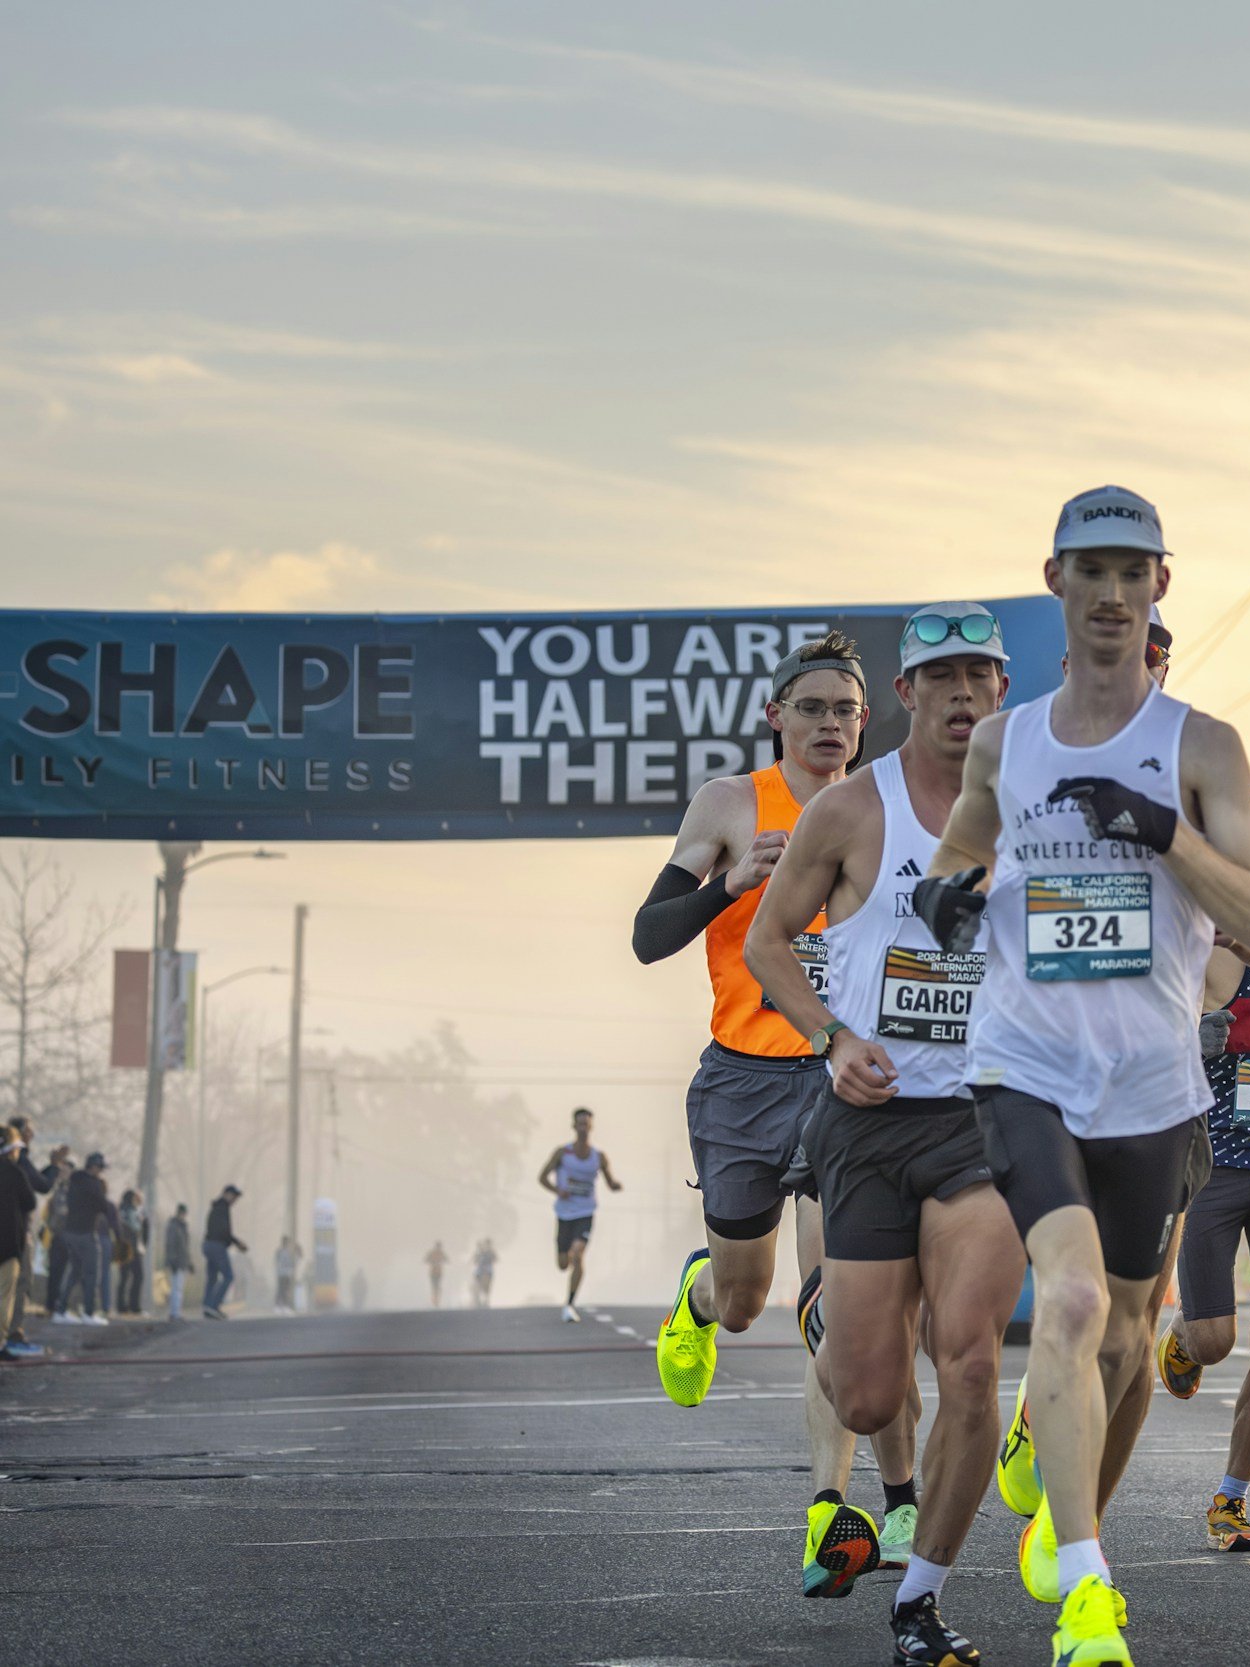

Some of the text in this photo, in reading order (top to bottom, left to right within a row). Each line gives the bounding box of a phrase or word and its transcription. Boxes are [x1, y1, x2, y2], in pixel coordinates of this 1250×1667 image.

[477, 624, 650, 677] YOU
[479, 677, 774, 738] HALFWA
[11, 752, 413, 792] ILY FITNESS
[479, 739, 774, 805] THER
[1015, 841, 1099, 862] ATHLETIC
[1081, 874, 1149, 887] CALIFORNIA
[1060, 886, 1149, 898] INTERNATIONAL
[1084, 897, 1149, 908] MARATHON
[1055, 914, 1122, 948] 324
[916, 952, 941, 961] 2024
[947, 953, 986, 963] CALIFOR
[1090, 958, 1150, 970] MARATHON
[896, 985, 972, 1015] GARCI
[931, 1024, 966, 1040] ELIT
